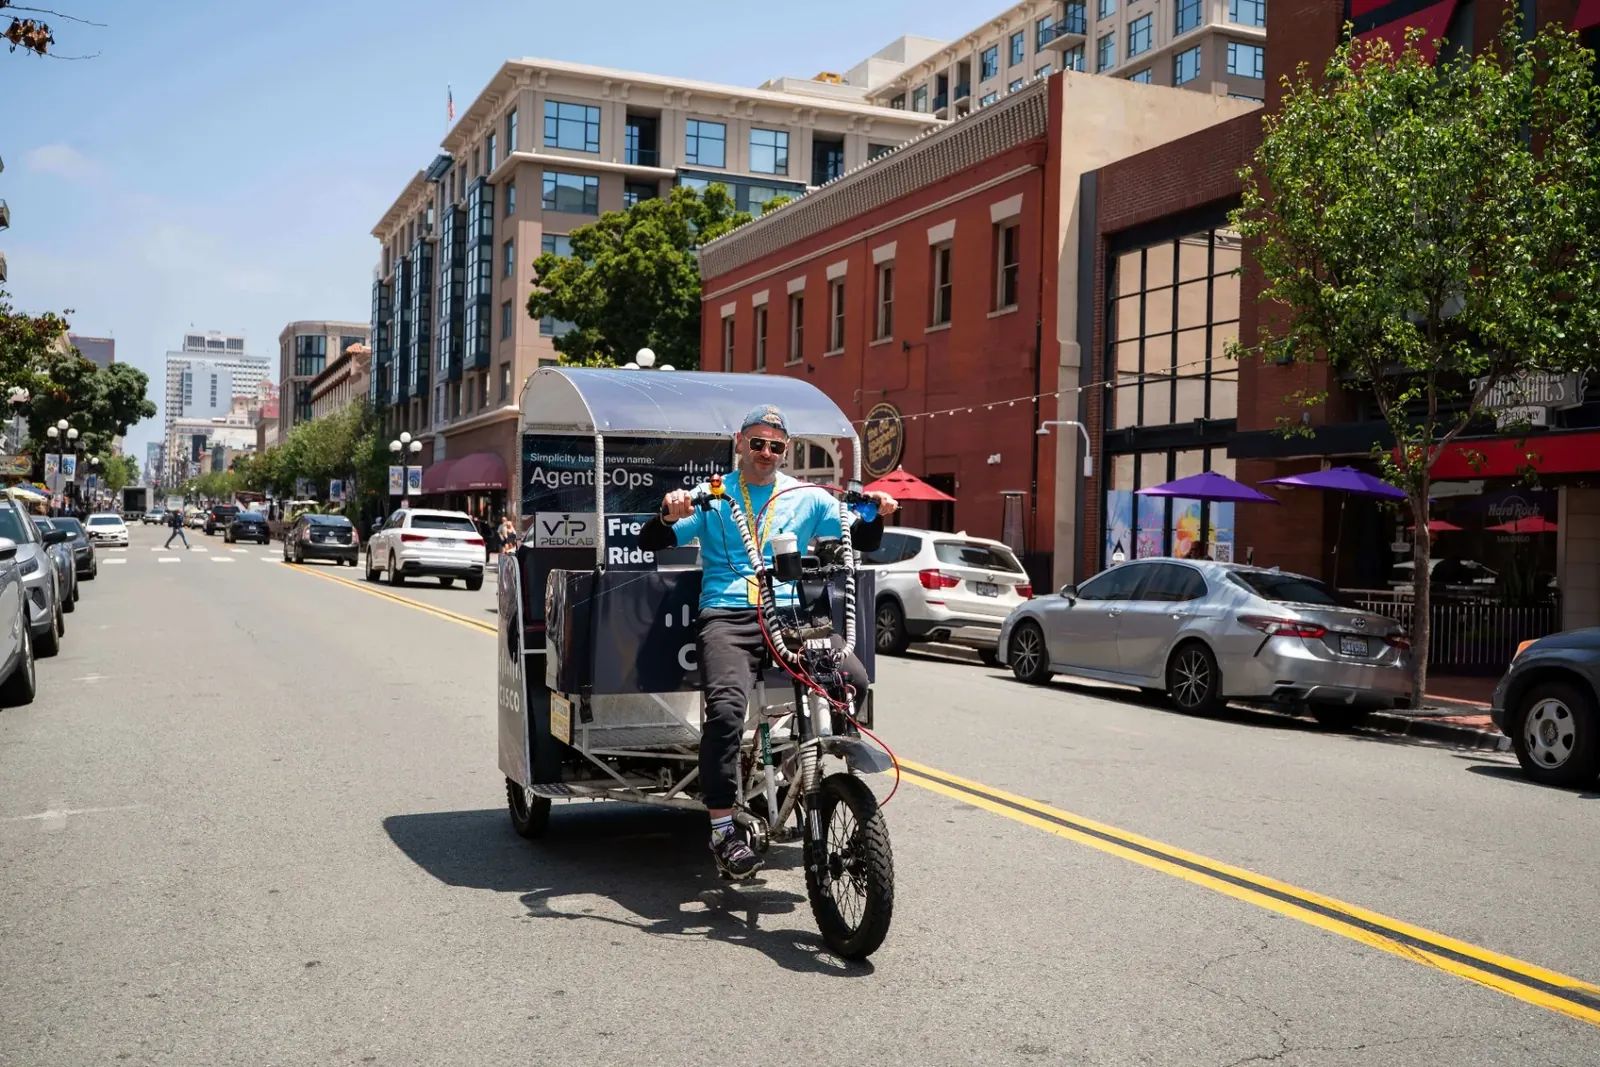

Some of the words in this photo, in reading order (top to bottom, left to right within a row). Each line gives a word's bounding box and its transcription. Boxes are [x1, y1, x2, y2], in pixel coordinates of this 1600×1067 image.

[530, 453, 576, 464] Simplicity
[579, 454, 595, 463] has
[605, 456, 625, 464] new
[627, 456, 655, 464] name:
[530, 467, 654, 490] AgentcOps
[683, 475, 710, 485] CISC
[1488, 503, 1514, 517] Hard
[1515, 503, 1540, 518] Rock
[608, 518, 646, 537] Fre
[540, 537, 594, 546] PEDICAB
[608, 544, 655, 565] Ride
